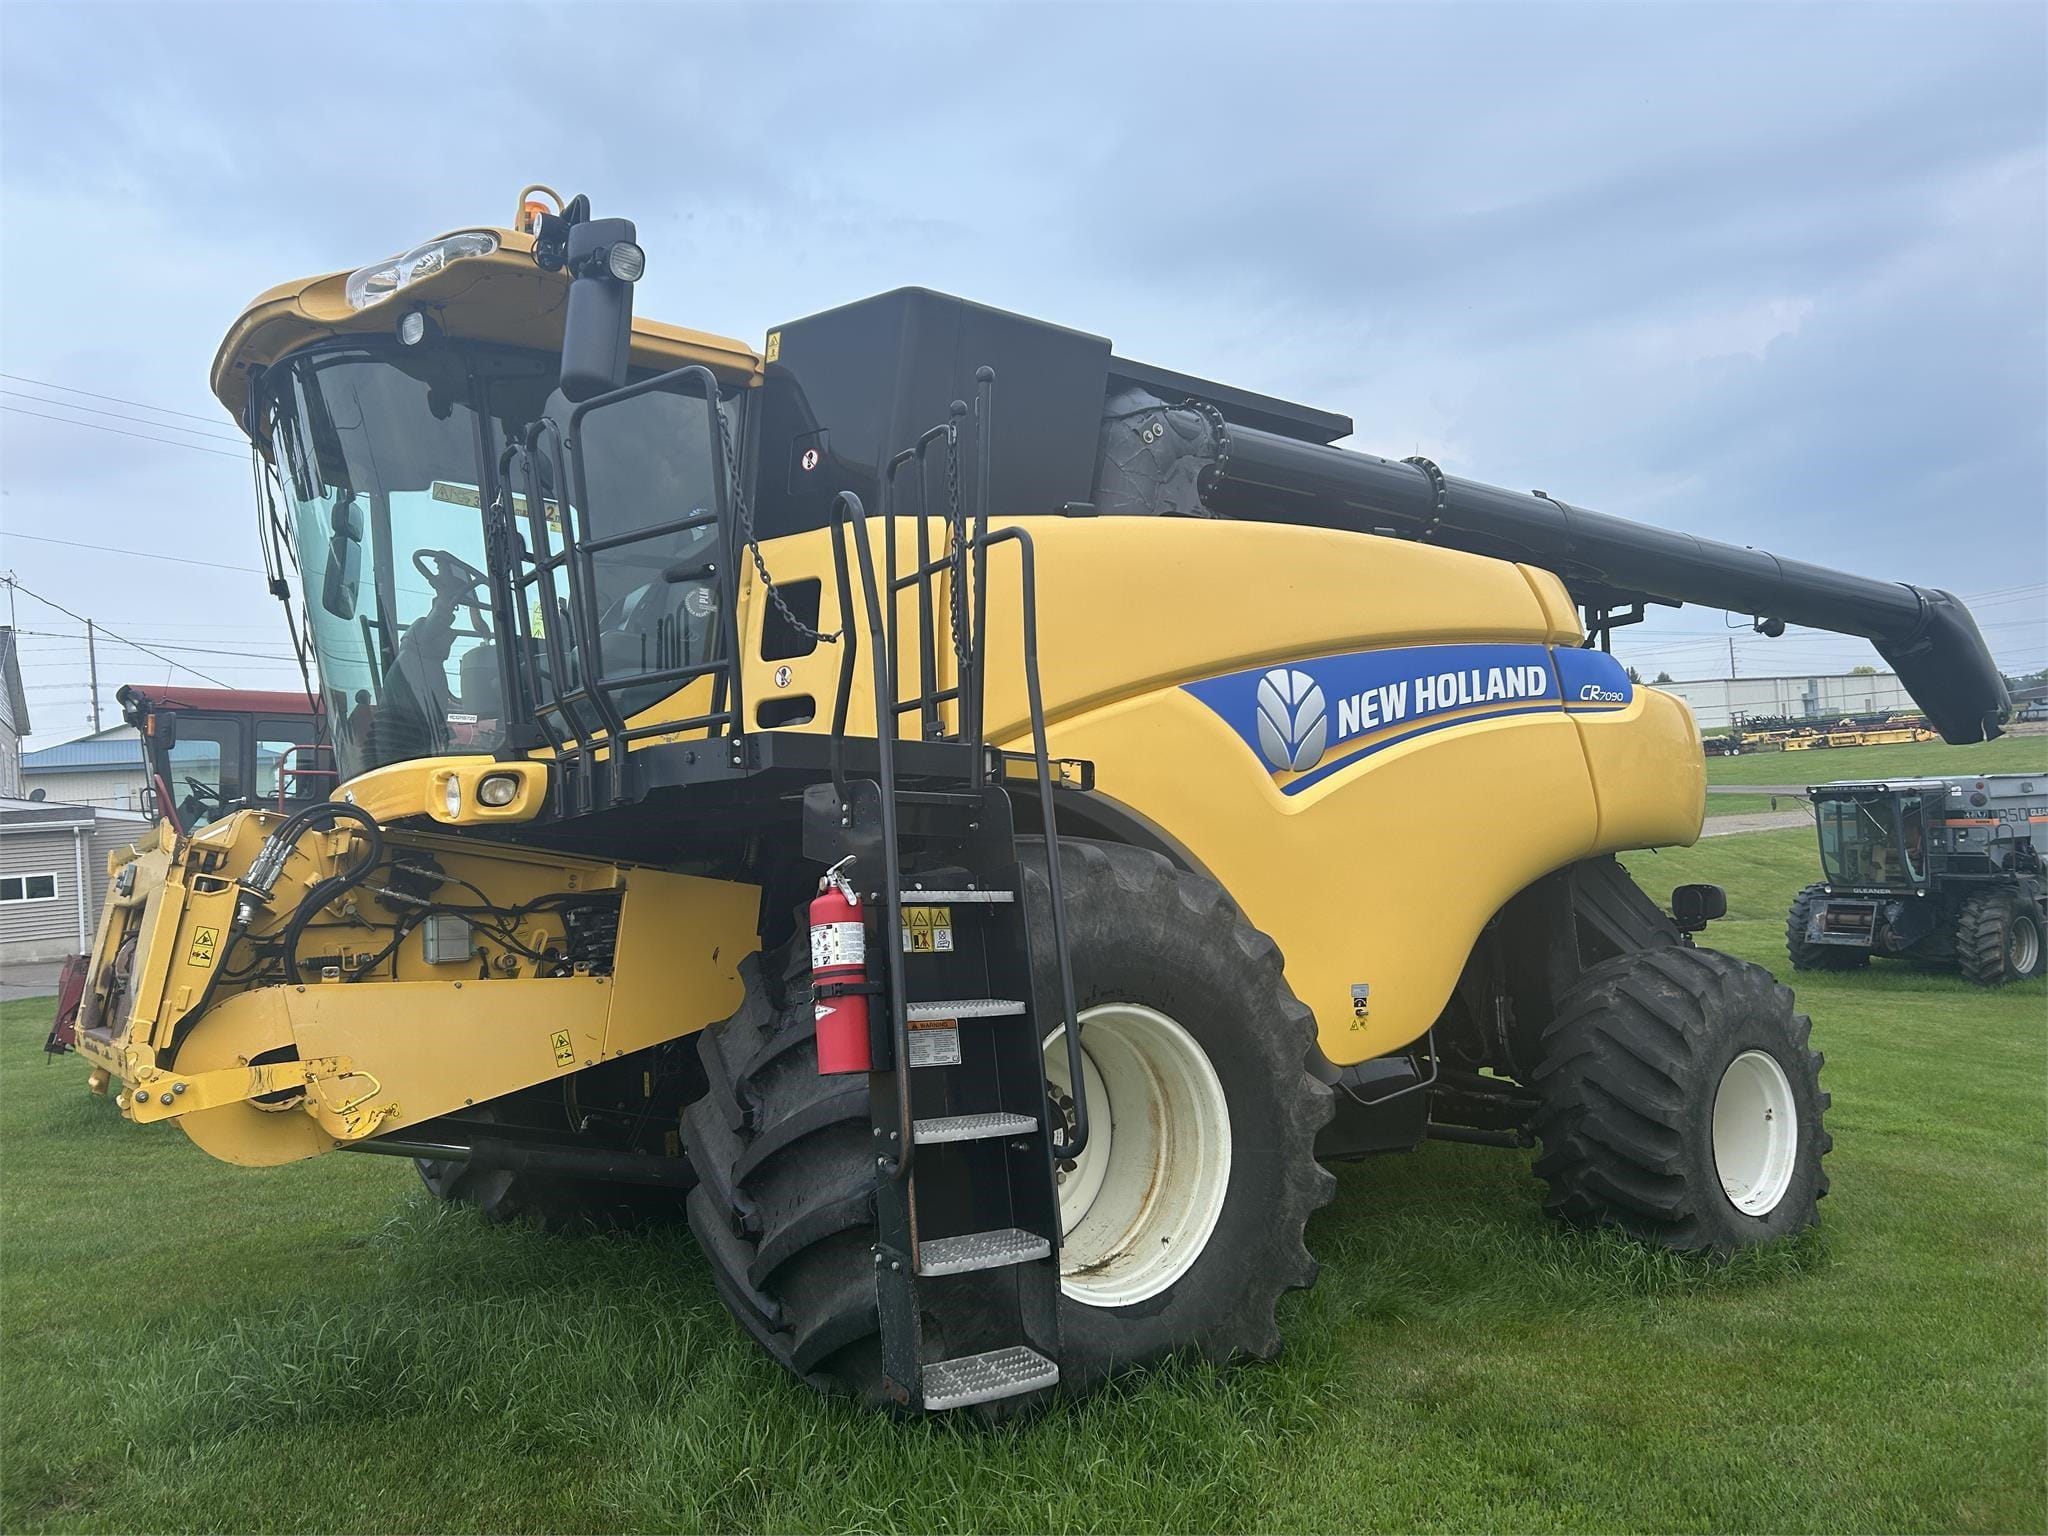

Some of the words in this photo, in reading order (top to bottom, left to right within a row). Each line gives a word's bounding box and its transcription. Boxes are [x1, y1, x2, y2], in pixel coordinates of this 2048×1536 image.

[1338, 681, 1407, 738] NEW
[1415, 666, 1547, 714] HOLLAND
[1580, 684, 1624, 701] CR7090
